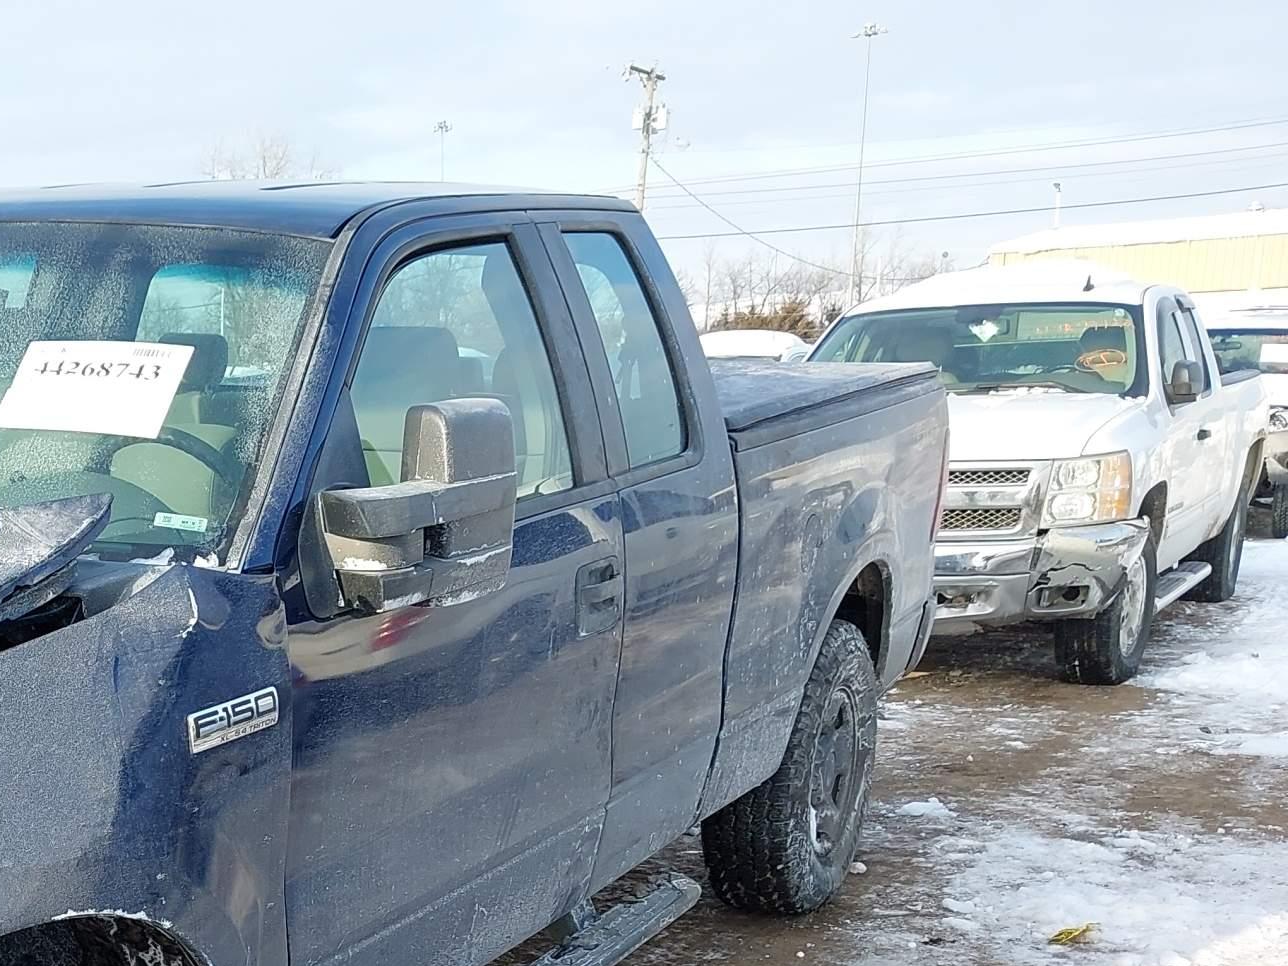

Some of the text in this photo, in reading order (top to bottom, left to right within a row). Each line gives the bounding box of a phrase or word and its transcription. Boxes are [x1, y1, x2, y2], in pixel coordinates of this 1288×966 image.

[34, 360, 163, 380] 44268743
[193, 691, 277, 738] F-150
[249, 718, 277, 732] TRITON
